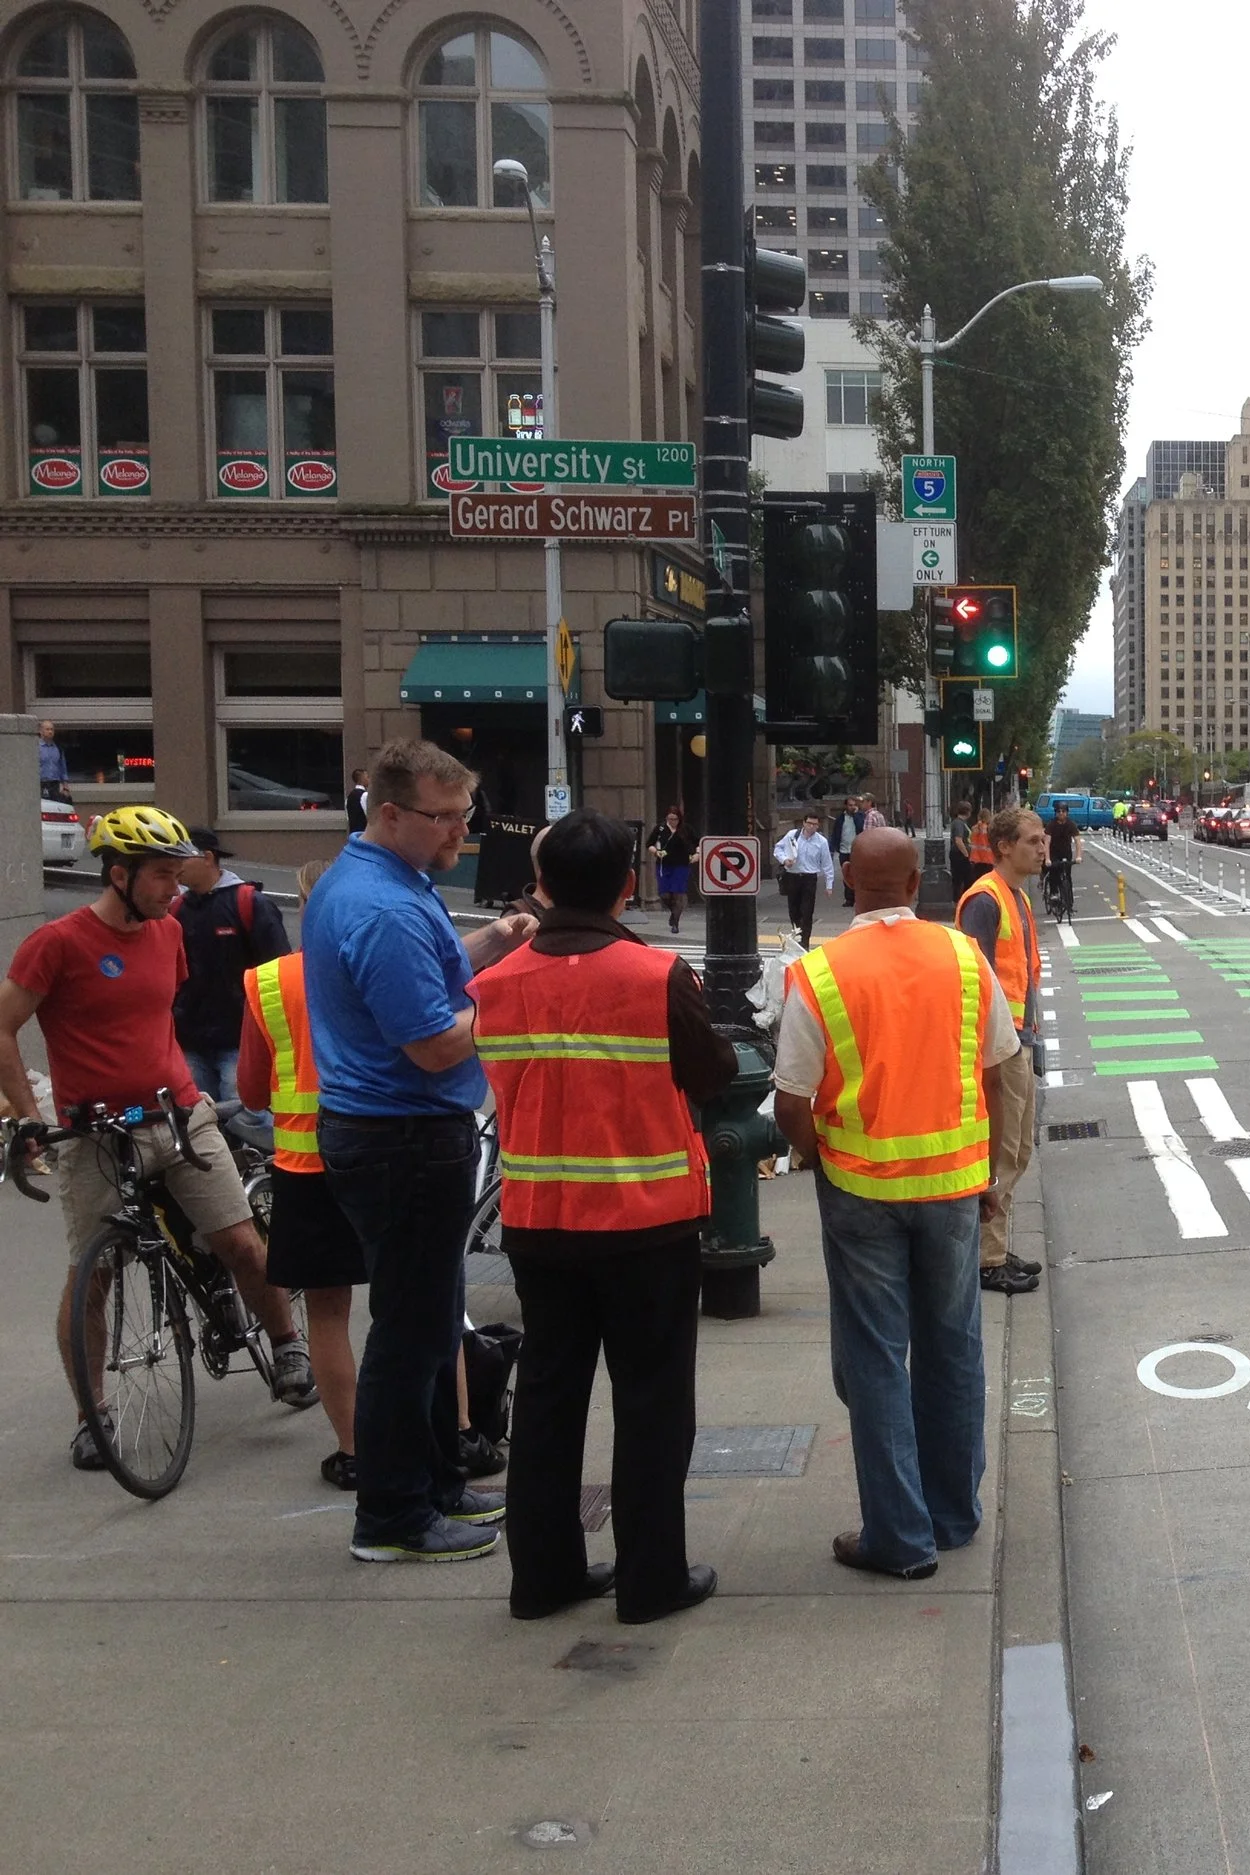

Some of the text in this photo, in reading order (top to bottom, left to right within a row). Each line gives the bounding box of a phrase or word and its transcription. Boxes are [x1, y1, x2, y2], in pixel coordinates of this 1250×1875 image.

[456, 443, 689, 483] University St 1200
[912, 459, 945, 468] NORTH
[36, 464, 77, 480] Melange
[105, 465, 145, 480] Melange
[223, 466, 264, 481] Melange
[291, 467, 332, 482] Melange
[924, 481, 935, 497] 5
[457, 496, 689, 532] Gerard Schwarz Pl
[913, 527, 952, 537] EFT TURN
[923, 539, 936, 548] ON
[916, 570, 944, 581] ONLY
[501, 822, 536, 834] VALET
